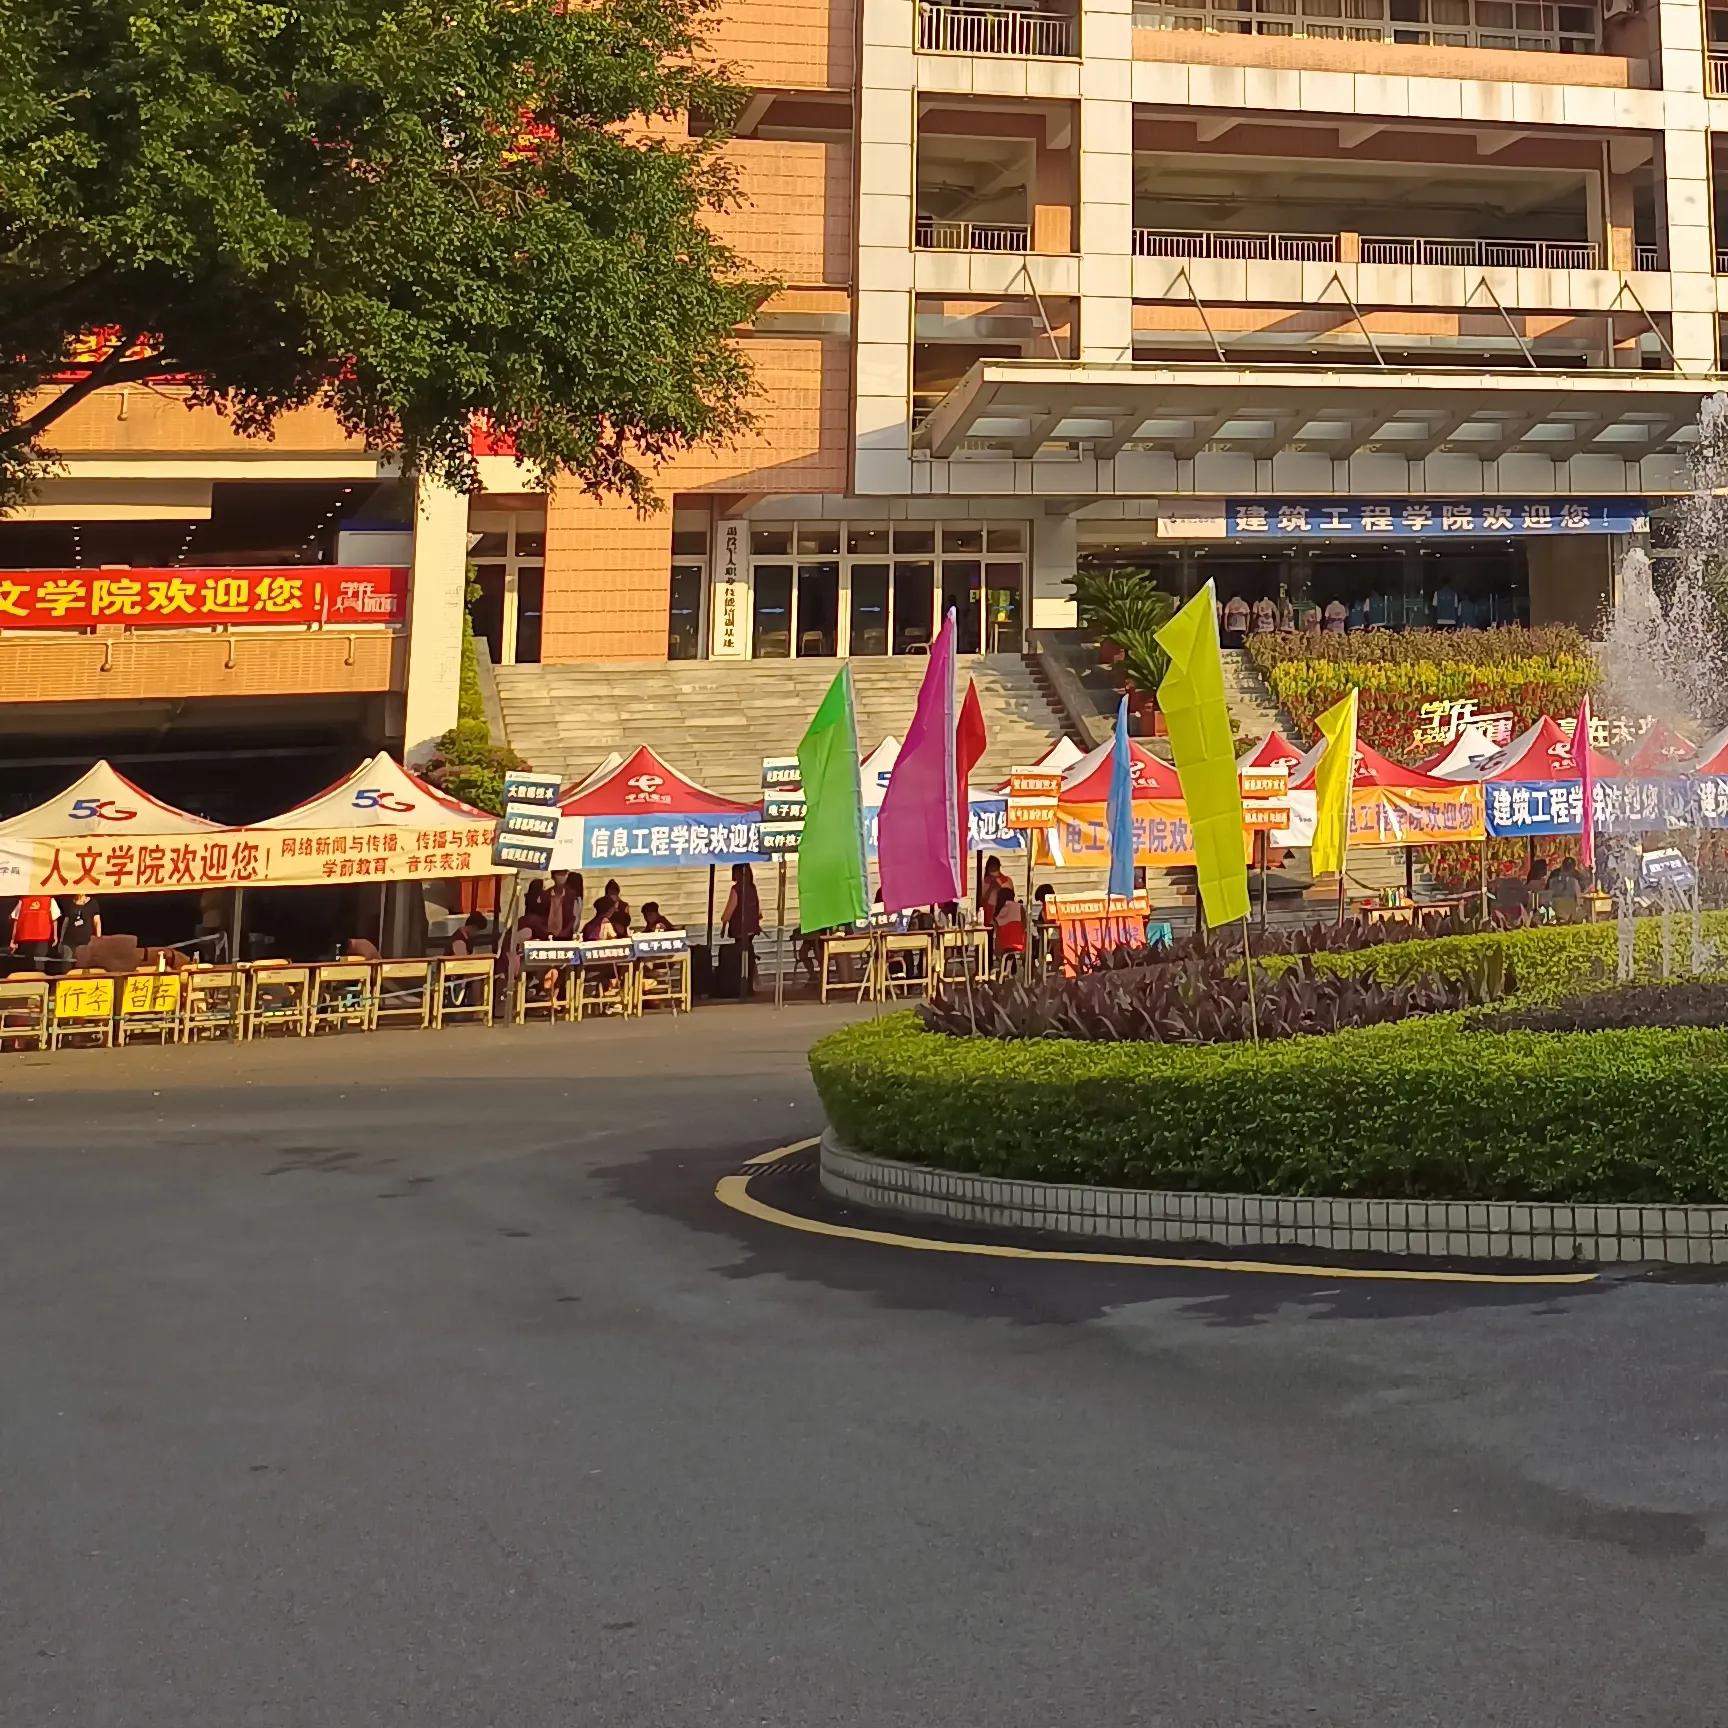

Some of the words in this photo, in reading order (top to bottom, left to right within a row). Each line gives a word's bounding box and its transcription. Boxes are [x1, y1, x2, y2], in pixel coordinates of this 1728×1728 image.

[68, 798, 138, 821] 5G
[352, 788, 416, 812] 5G
[322, 852, 472, 878] 学前教育、音乐表演
